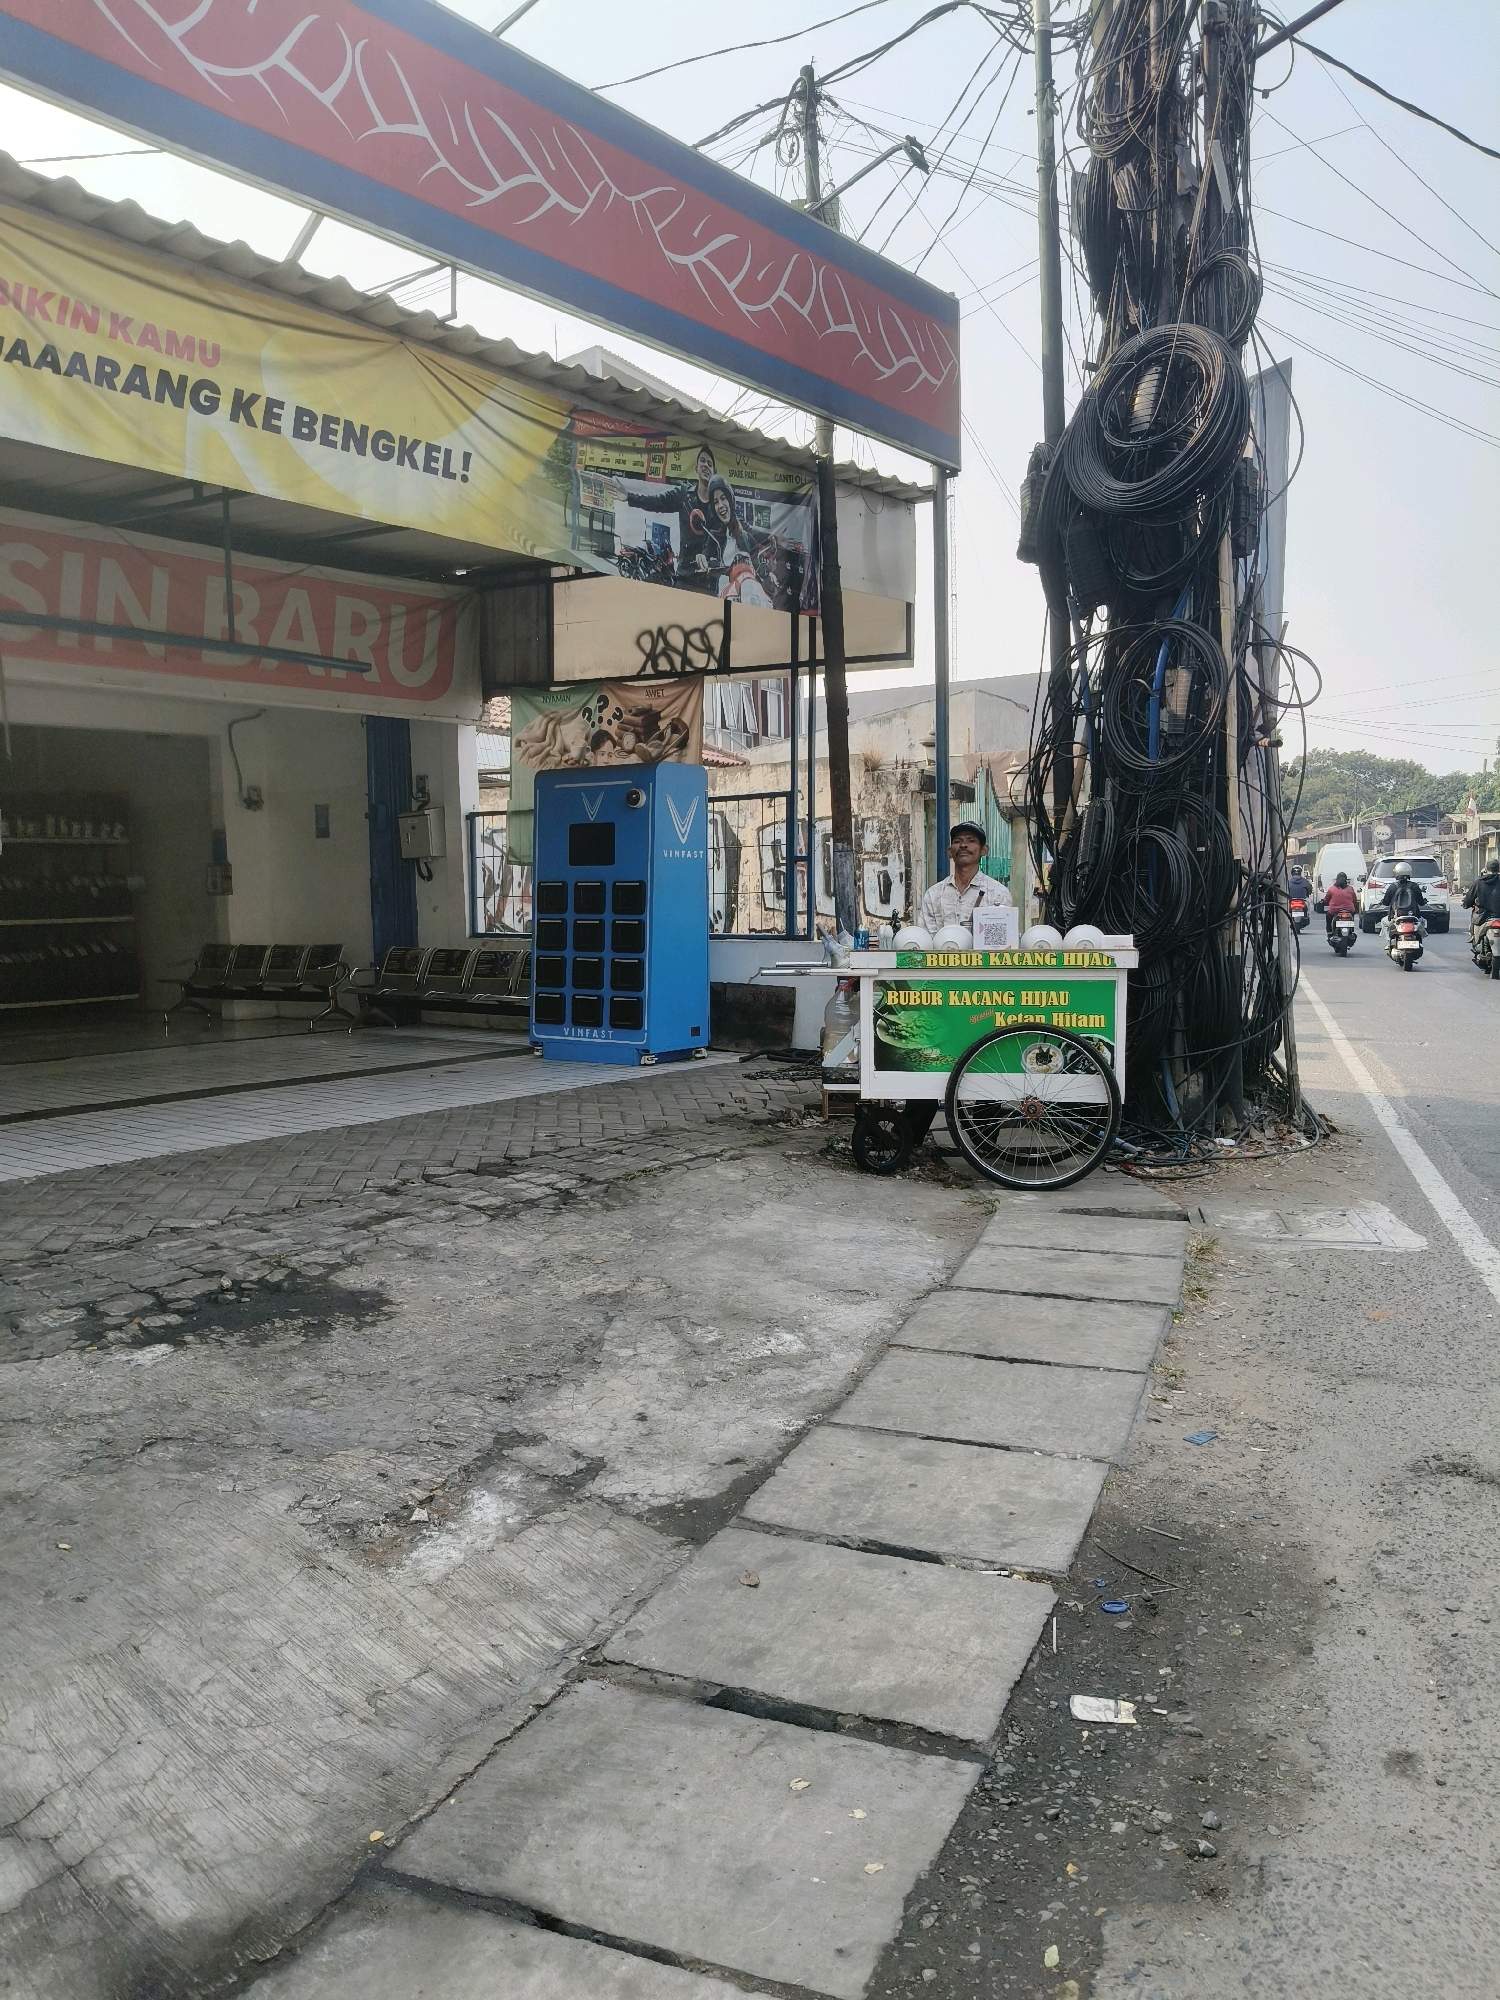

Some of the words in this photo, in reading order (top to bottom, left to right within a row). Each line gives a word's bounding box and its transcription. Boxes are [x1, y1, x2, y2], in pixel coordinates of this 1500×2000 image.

[108, 312, 220, 368] KAMU
[0, 336, 221, 415] AAARANG
[229, 387, 285, 435] KE
[292, 405, 472, 484] BENGKEL!
[728, 468, 744, 478] SPARE
[744, 470, 758, 480] PART
[773, 473, 794, 484] GANTI
[202, 575, 440, 688] BARU
[542, 694, 571, 703] NYAMAN
[644, 688, 665, 698] AWET
[663, 849, 704, 859] VINFAST
[925, 952, 983, 967] BUBUR
[987, 952, 1057, 967] KACANG
[1062, 952, 1112, 968] HIJAU
[886, 989, 943, 1006] BUBUR
[948, 990, 1015, 1006] KACANG
[1020, 990, 1070, 1007] HIJAU
[1051, 1012, 1106, 1028] Hitam
[563, 1027, 614, 1040] VINFAST
